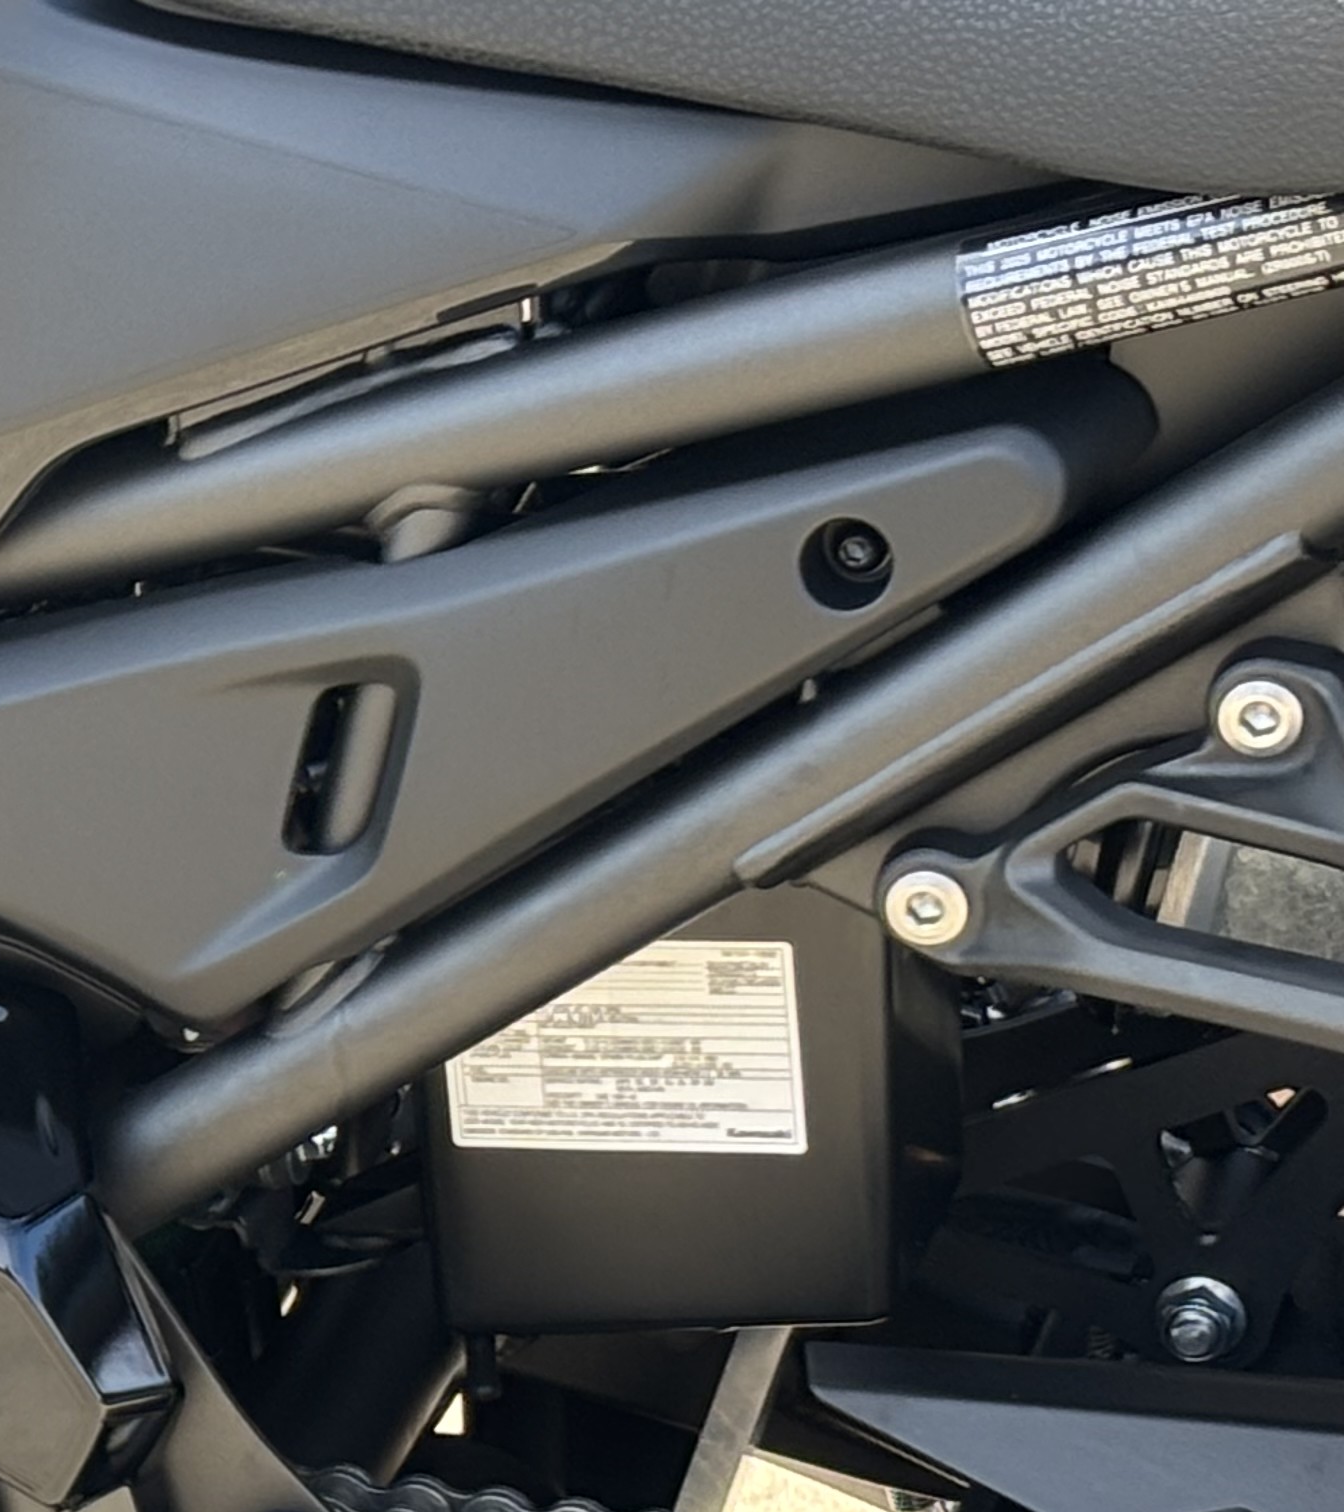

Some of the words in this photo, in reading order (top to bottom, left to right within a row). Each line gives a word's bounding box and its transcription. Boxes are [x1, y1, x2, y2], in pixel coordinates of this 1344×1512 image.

[1036, 230, 1127, 262] MOTORCYCLE
[1134, 219, 1180, 240] MEETS
[1186, 211, 1215, 229] EPA
[1221, 201, 1263, 221] NOISE
[1127, 252, 1174, 274] CAUSE
[1180, 243, 1212, 262] THIS
[1217, 222, 1311, 254] MOTORCYCLE
[1318, 216, 1338, 232] TO
[1200, 222, 1236, 242] TEST
[971, 300, 1026, 324] EXCEED
[1030, 285, 1092, 311] FEDERAL
[1097, 275, 1140, 296] NOISE
[1146, 256, 1229, 285] STANDARDS
